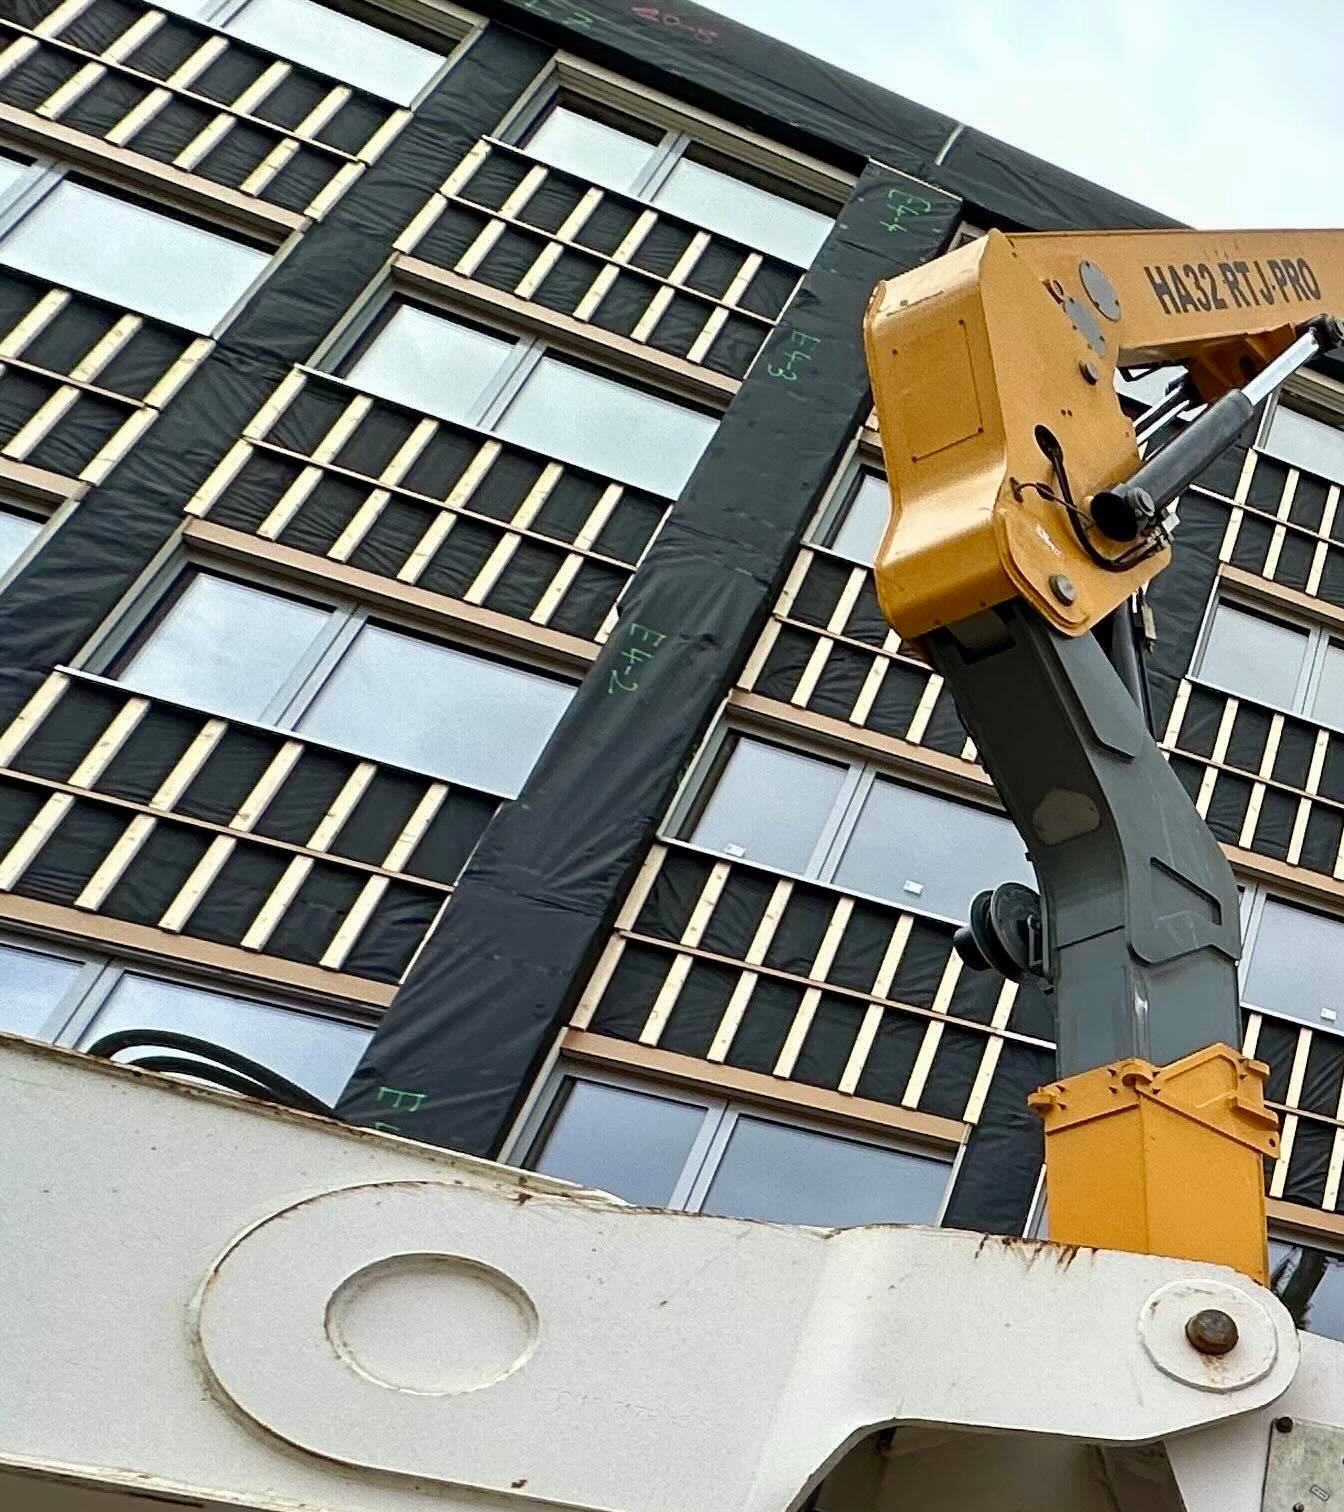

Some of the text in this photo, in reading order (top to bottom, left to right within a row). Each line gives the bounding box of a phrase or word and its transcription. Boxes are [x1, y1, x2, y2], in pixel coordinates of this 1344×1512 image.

[1143, 261, 1229, 315] HA32
[767, 330, 822, 381] E4-3
[607, 622, 668, 695] E4-2
